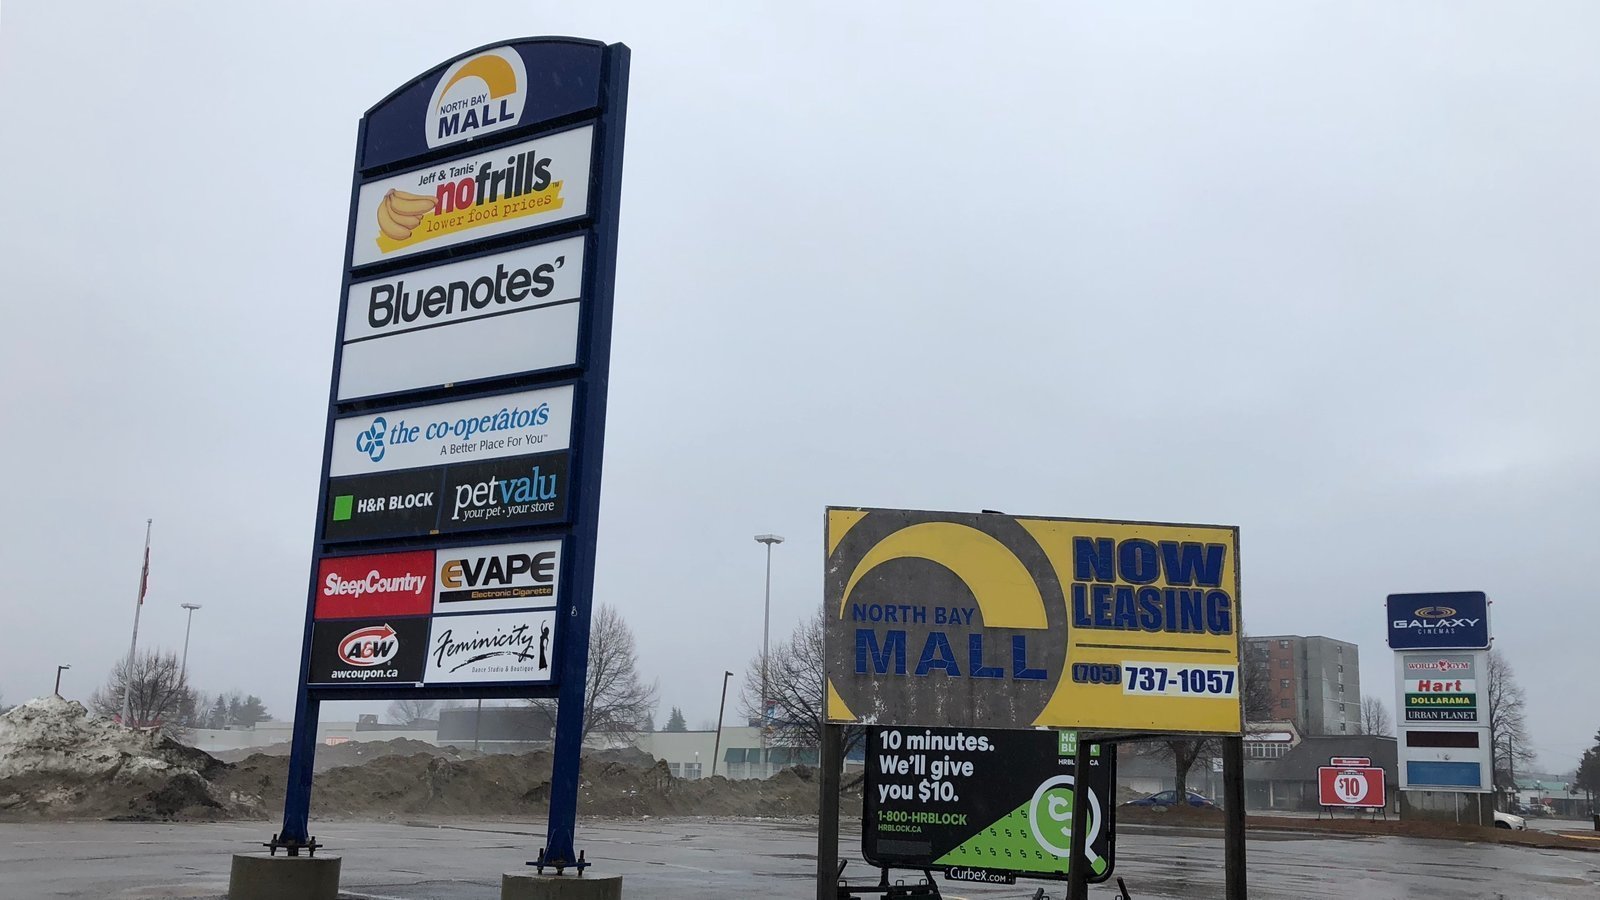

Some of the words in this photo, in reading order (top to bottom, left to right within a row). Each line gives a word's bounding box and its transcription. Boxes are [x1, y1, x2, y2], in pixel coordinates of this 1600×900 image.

[440, 99, 469, 115] NORTH
[471, 93, 488, 107] BAY
[438, 99, 515, 139] MALL
[418, 169, 436, 186] Jeff
[438, 169, 447, 181] &
[449, 161, 478, 178] Tanis'
[426, 216, 464, 233] lower
[468, 206, 499, 224] food
[503, 194, 552, 216] prices
[389, 420, 420, 445] the
[426, 402, 550, 441] co-operators
[440, 445, 447, 455] A
[450, 442, 476, 455] Better
[480, 438, 505, 452] Place
[507, 436, 522, 448] For
[357, 497, 385, 513] H&R
[388, 491, 434, 510] BLOCK
[462, 509, 485, 522] your
[486, 506, 501, 519] pet
[507, 504, 528, 517] your
[530, 501, 555, 513] store
[441, 551, 556, 589] EVAPE
[1072, 536, 1227, 588] NOW
[471, 588, 512, 599] Electronic
[512, 586, 552, 597] Cigarette
[852, 603, 927, 624] NORTH
[935, 606, 975, 625] BAY
[1071, 582, 1233, 635] LEASING
[1393, 618, 1480, 629] GALAXY
[347, 640, 395, 658] A&W
[433, 623, 534, 668] Feminicity
[855, 628, 1048, 681] MALL
[331, 669, 399, 681] awcoupon.ca
[487, 665, 504, 673] Studio
[510, 665, 534, 673] Boutique
[1448, 662, 1470, 670] GYM
[1072, 662, 1122, 684] (705)
[1125, 665, 1235, 694] 737-1057
[1418, 680, 1462, 692] Hart
[1408, 711, 1438, 719] URBAN
[1441, 711, 1475, 719] PLANET
[879, 730, 901, 750] 10
[906, 730, 995, 752] minutes.
[879, 755, 926, 775] We'll
[930, 756, 974, 780] give
[878, 783, 913, 804] you
[918, 778, 959, 803] $10.
[1339, 777, 1360, 797] $10
[877, 810, 968, 826] 1-800-HRBLOCK
[878, 824, 922, 833] HRBLOCK.CA
